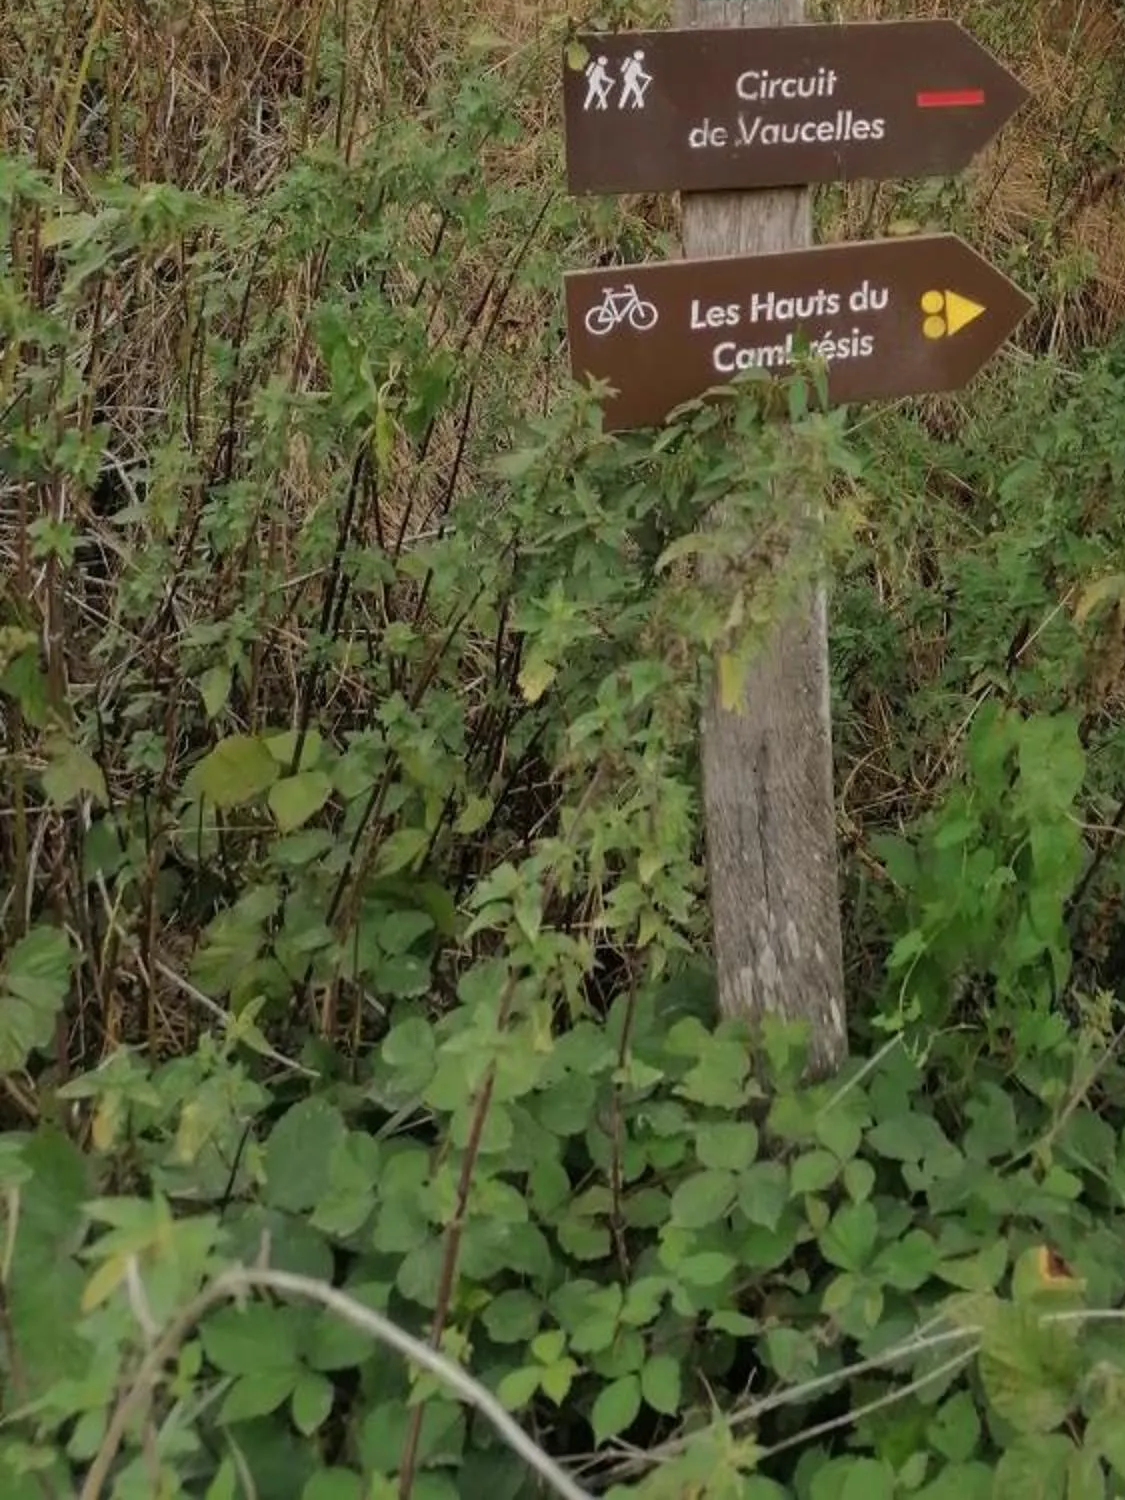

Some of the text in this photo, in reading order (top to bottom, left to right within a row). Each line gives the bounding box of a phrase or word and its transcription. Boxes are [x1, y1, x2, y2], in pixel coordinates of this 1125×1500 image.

[736, 67, 838, 101] Circuit
[688, 110, 886, 148] de Vaucelles
[690, 280, 889, 330] Les Hauts du
